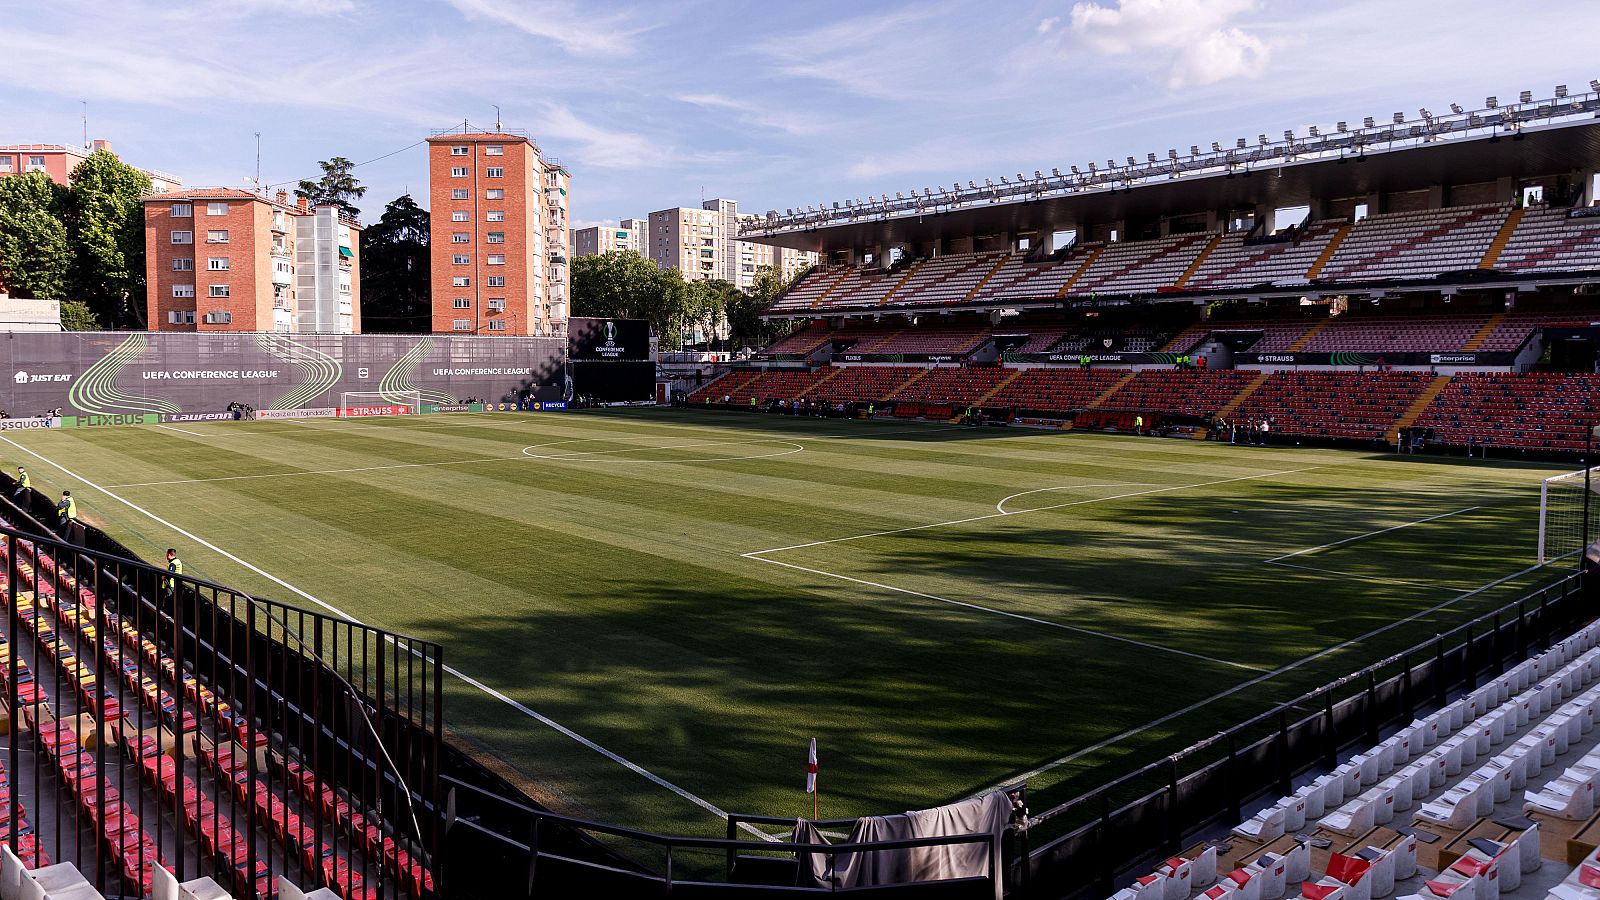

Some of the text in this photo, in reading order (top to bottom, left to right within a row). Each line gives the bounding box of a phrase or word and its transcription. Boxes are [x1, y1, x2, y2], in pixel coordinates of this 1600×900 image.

[30, 374, 72, 383] JUST EAT
[143, 370, 278, 380] UEFA CONFERENCE LEAGUE
[352, 407, 392, 415] STRAUSS
